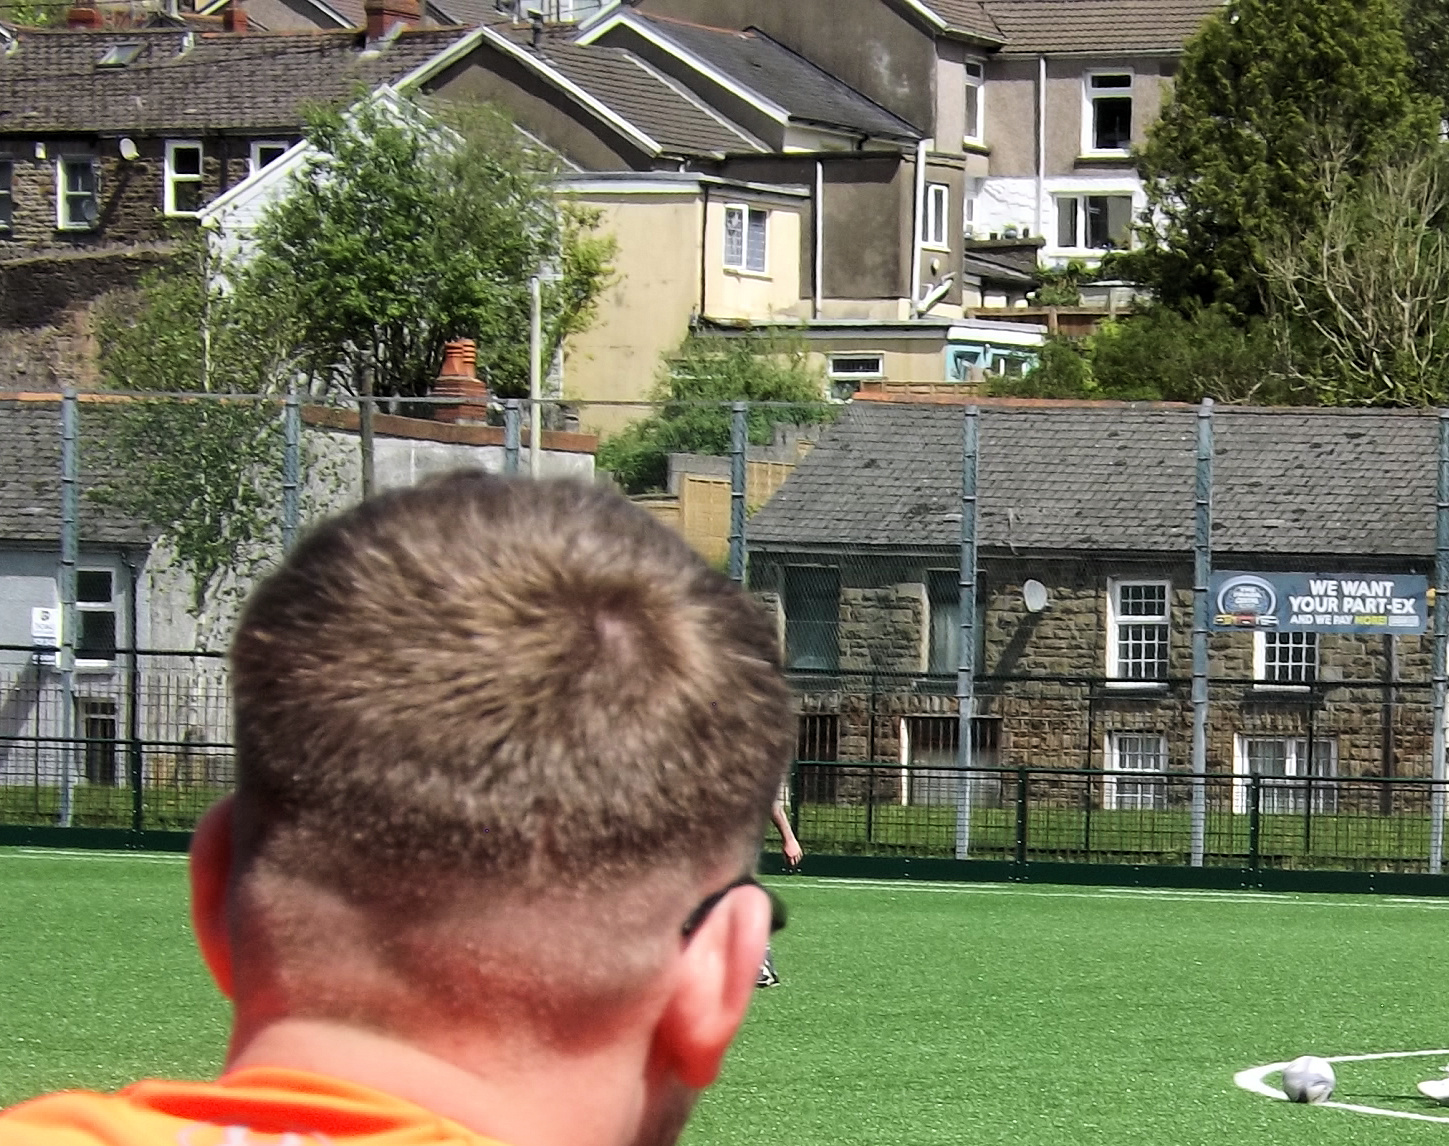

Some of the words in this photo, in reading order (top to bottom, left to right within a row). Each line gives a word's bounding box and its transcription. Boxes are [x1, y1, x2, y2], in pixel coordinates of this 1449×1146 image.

[1310, 579, 1338, 596] WE
[1341, 580, 1394, 597] WANT
[1289, 596, 1340, 613] YOUR
[1342, 598, 1416, 614] PART-EX
[1290, 615, 1314, 625] AND
[1315, 615, 1332, 625] WE
[1333, 616, 1353, 625] PAY
